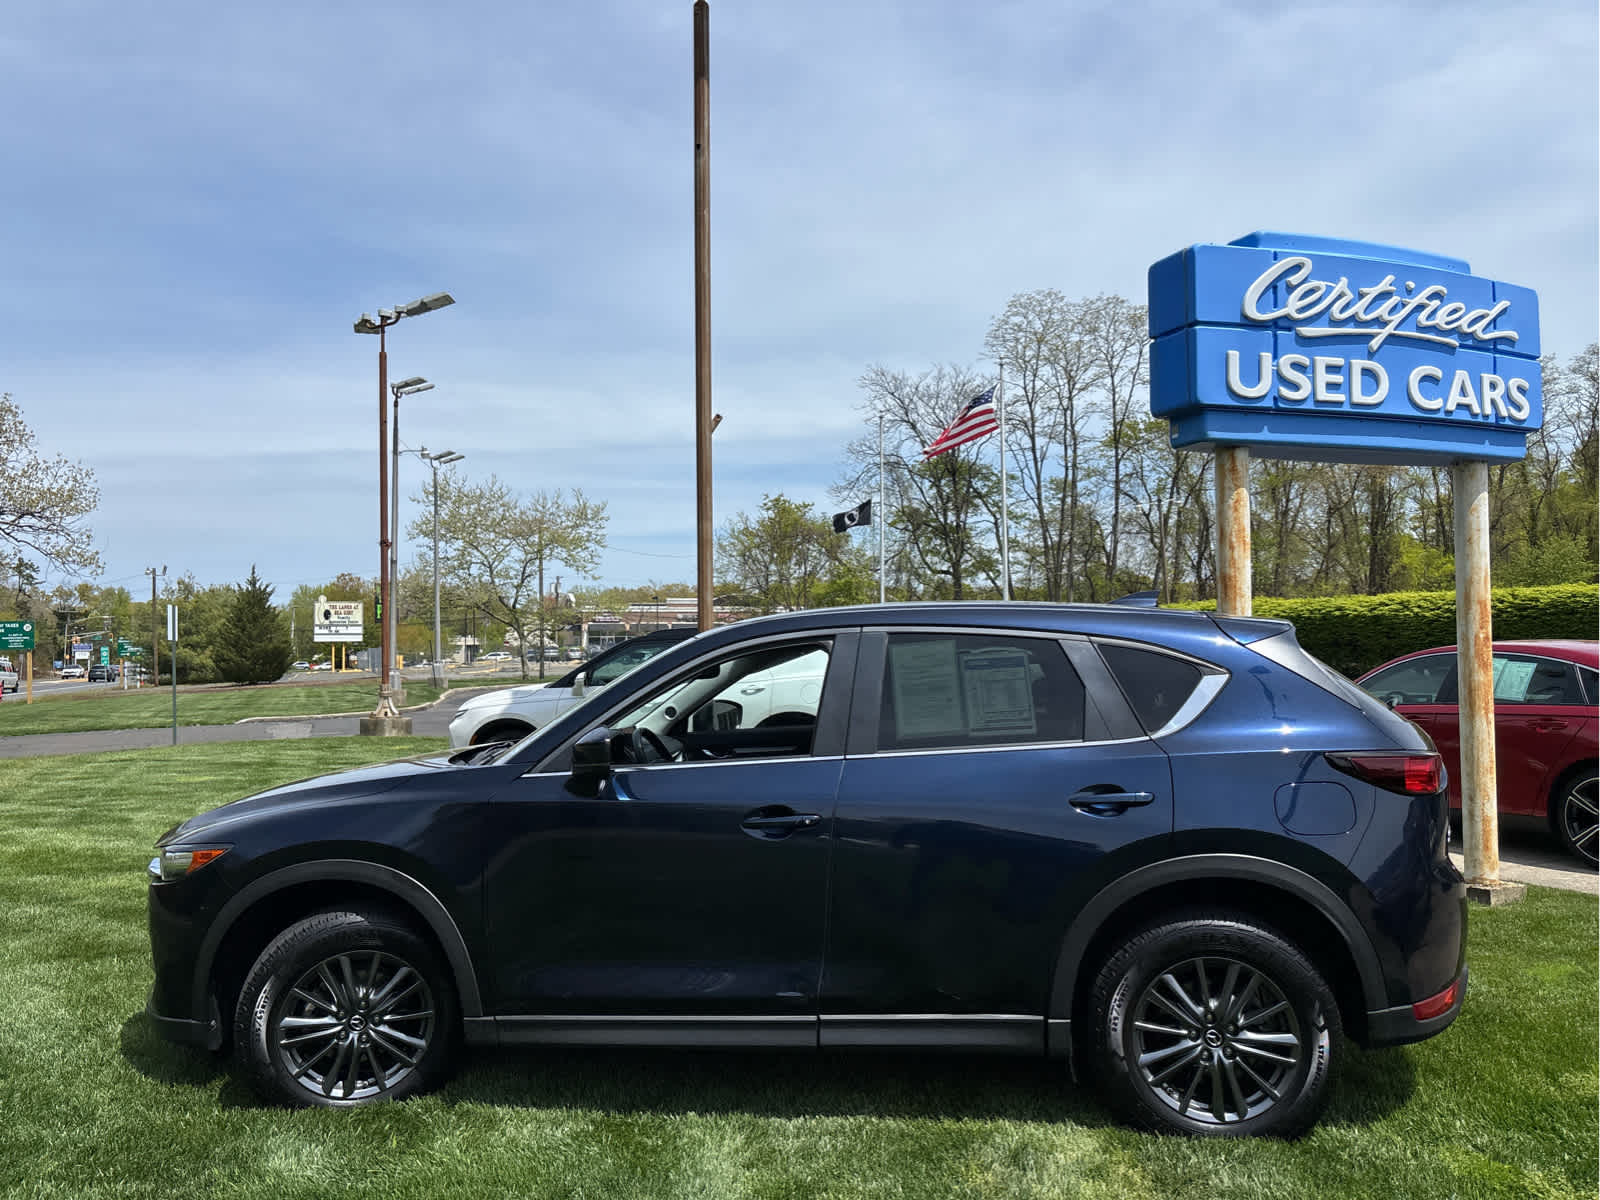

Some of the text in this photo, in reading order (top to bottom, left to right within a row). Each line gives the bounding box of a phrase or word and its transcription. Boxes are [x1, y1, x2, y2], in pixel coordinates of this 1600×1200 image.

[1242, 256, 1519, 353] Certified
[1226, 349, 1530, 422] USED CARS
